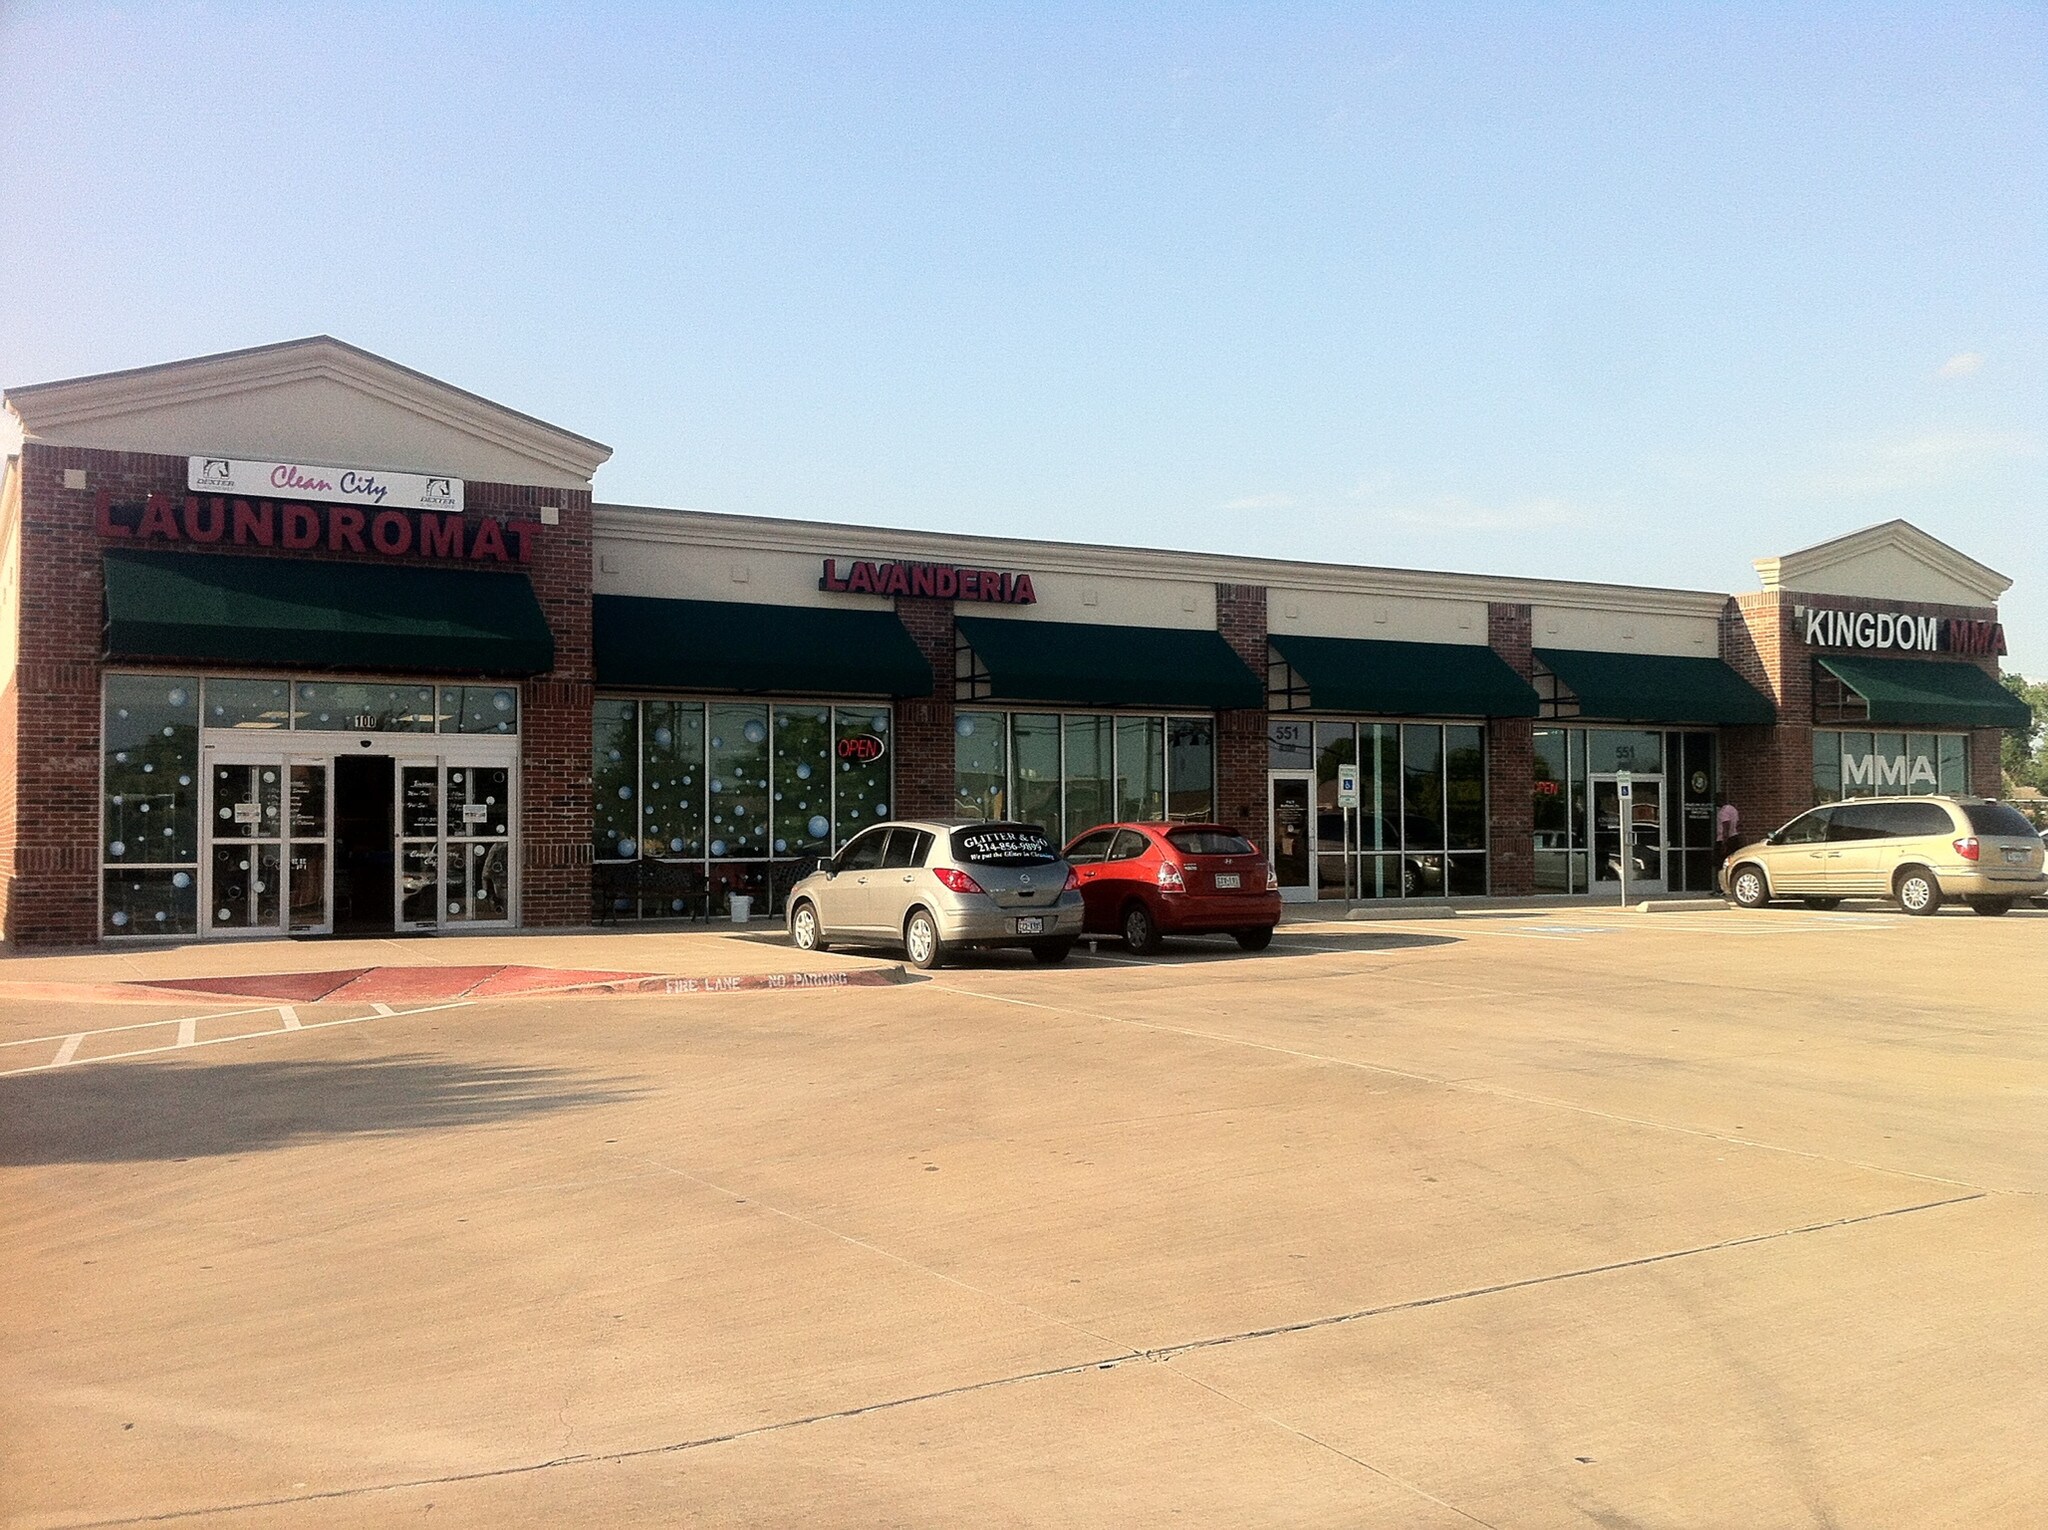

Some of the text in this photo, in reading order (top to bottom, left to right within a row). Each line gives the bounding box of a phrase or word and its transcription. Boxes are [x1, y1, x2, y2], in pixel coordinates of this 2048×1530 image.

[197, 478, 235, 487] DEXTER
[270, 465, 388, 504] Clean City
[420, 496, 456, 505] DEXTER
[97, 490, 542, 563] LAUNDROMAT
[823, 559, 1037, 604] LAVANDERIA
[1804, 609, 2007, 656] KINGDOM MMA
[355, 715, 376, 728] 100
[1276, 726, 1299, 740] 551
[838, 739, 878, 758] OPEN
[1616, 746, 1635, 759] 551
[1841, 754, 1937, 786] MMA
[963, 832, 1017, 848] GLITTER
[1019, 833, 1029, 842] &
[665, 972, 848, 994] FIRE LANE NO PARKING
